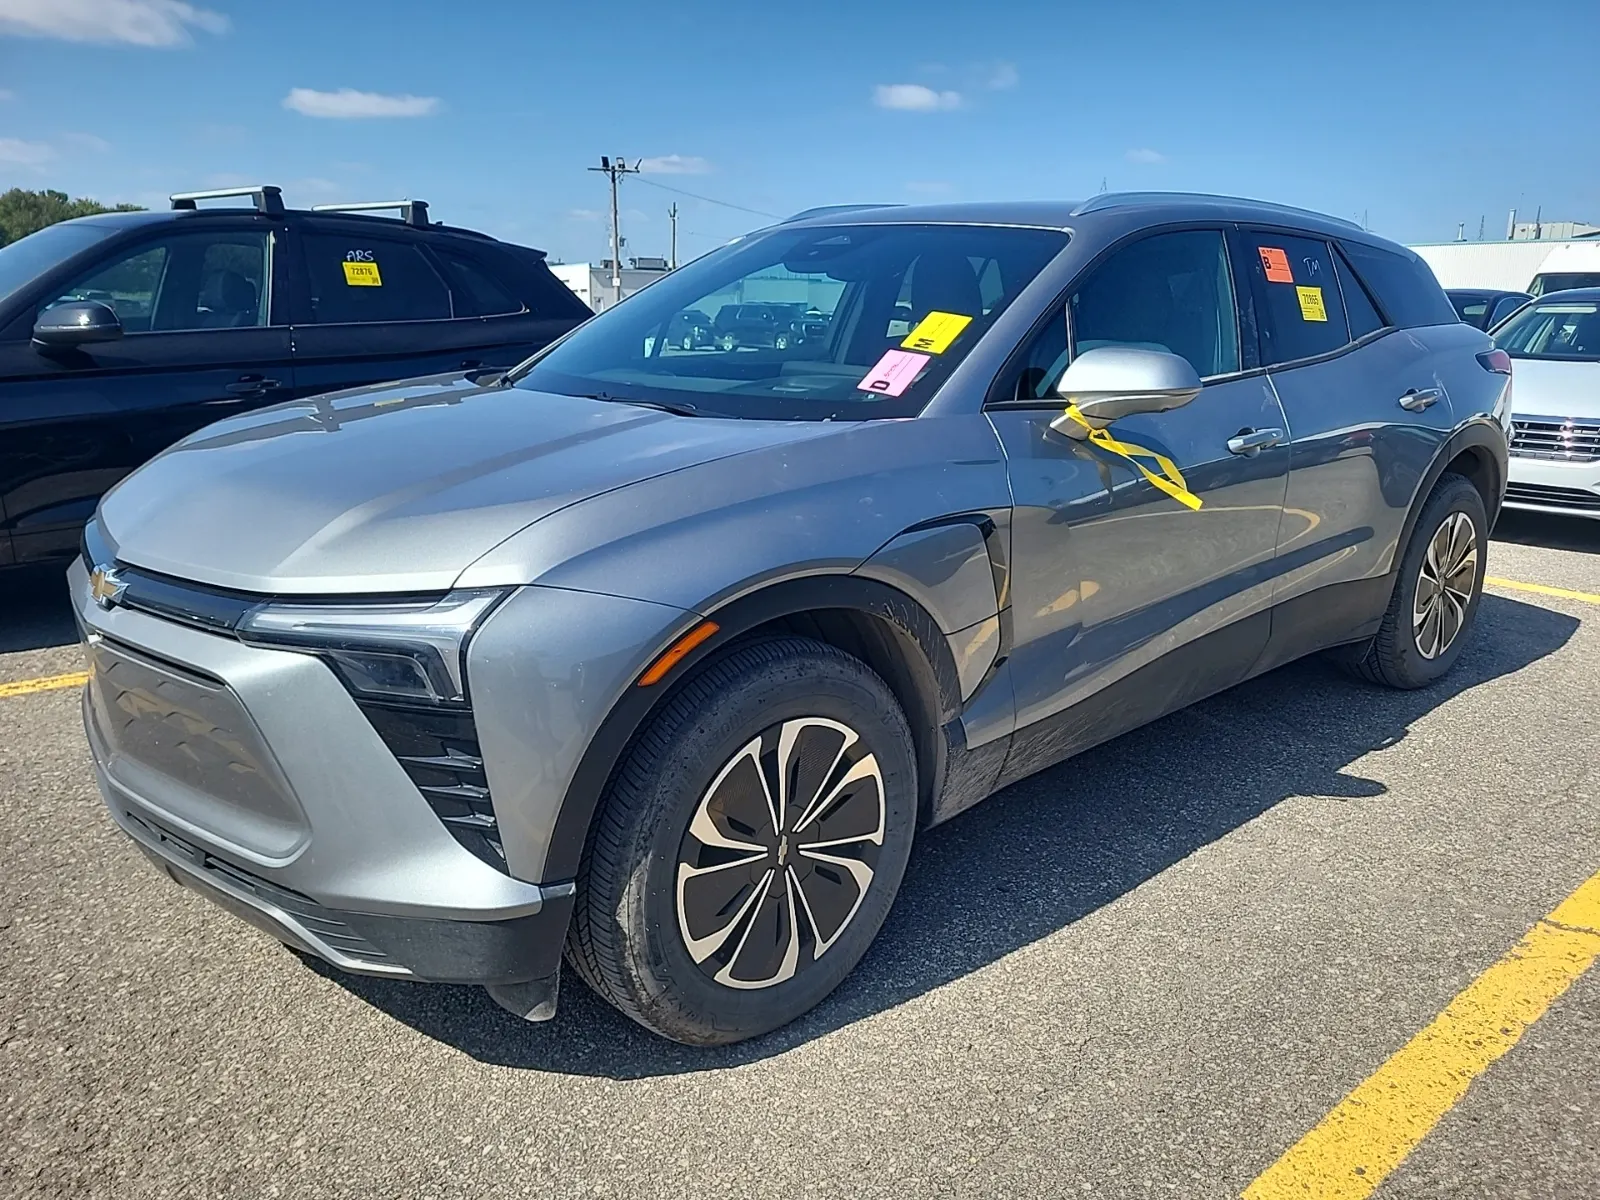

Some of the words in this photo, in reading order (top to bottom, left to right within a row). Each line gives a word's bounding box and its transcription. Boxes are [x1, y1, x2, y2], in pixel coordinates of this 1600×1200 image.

[1262, 255, 1272, 270] B
[913, 337, 935, 349] M
[869, 380, 890, 391] D
